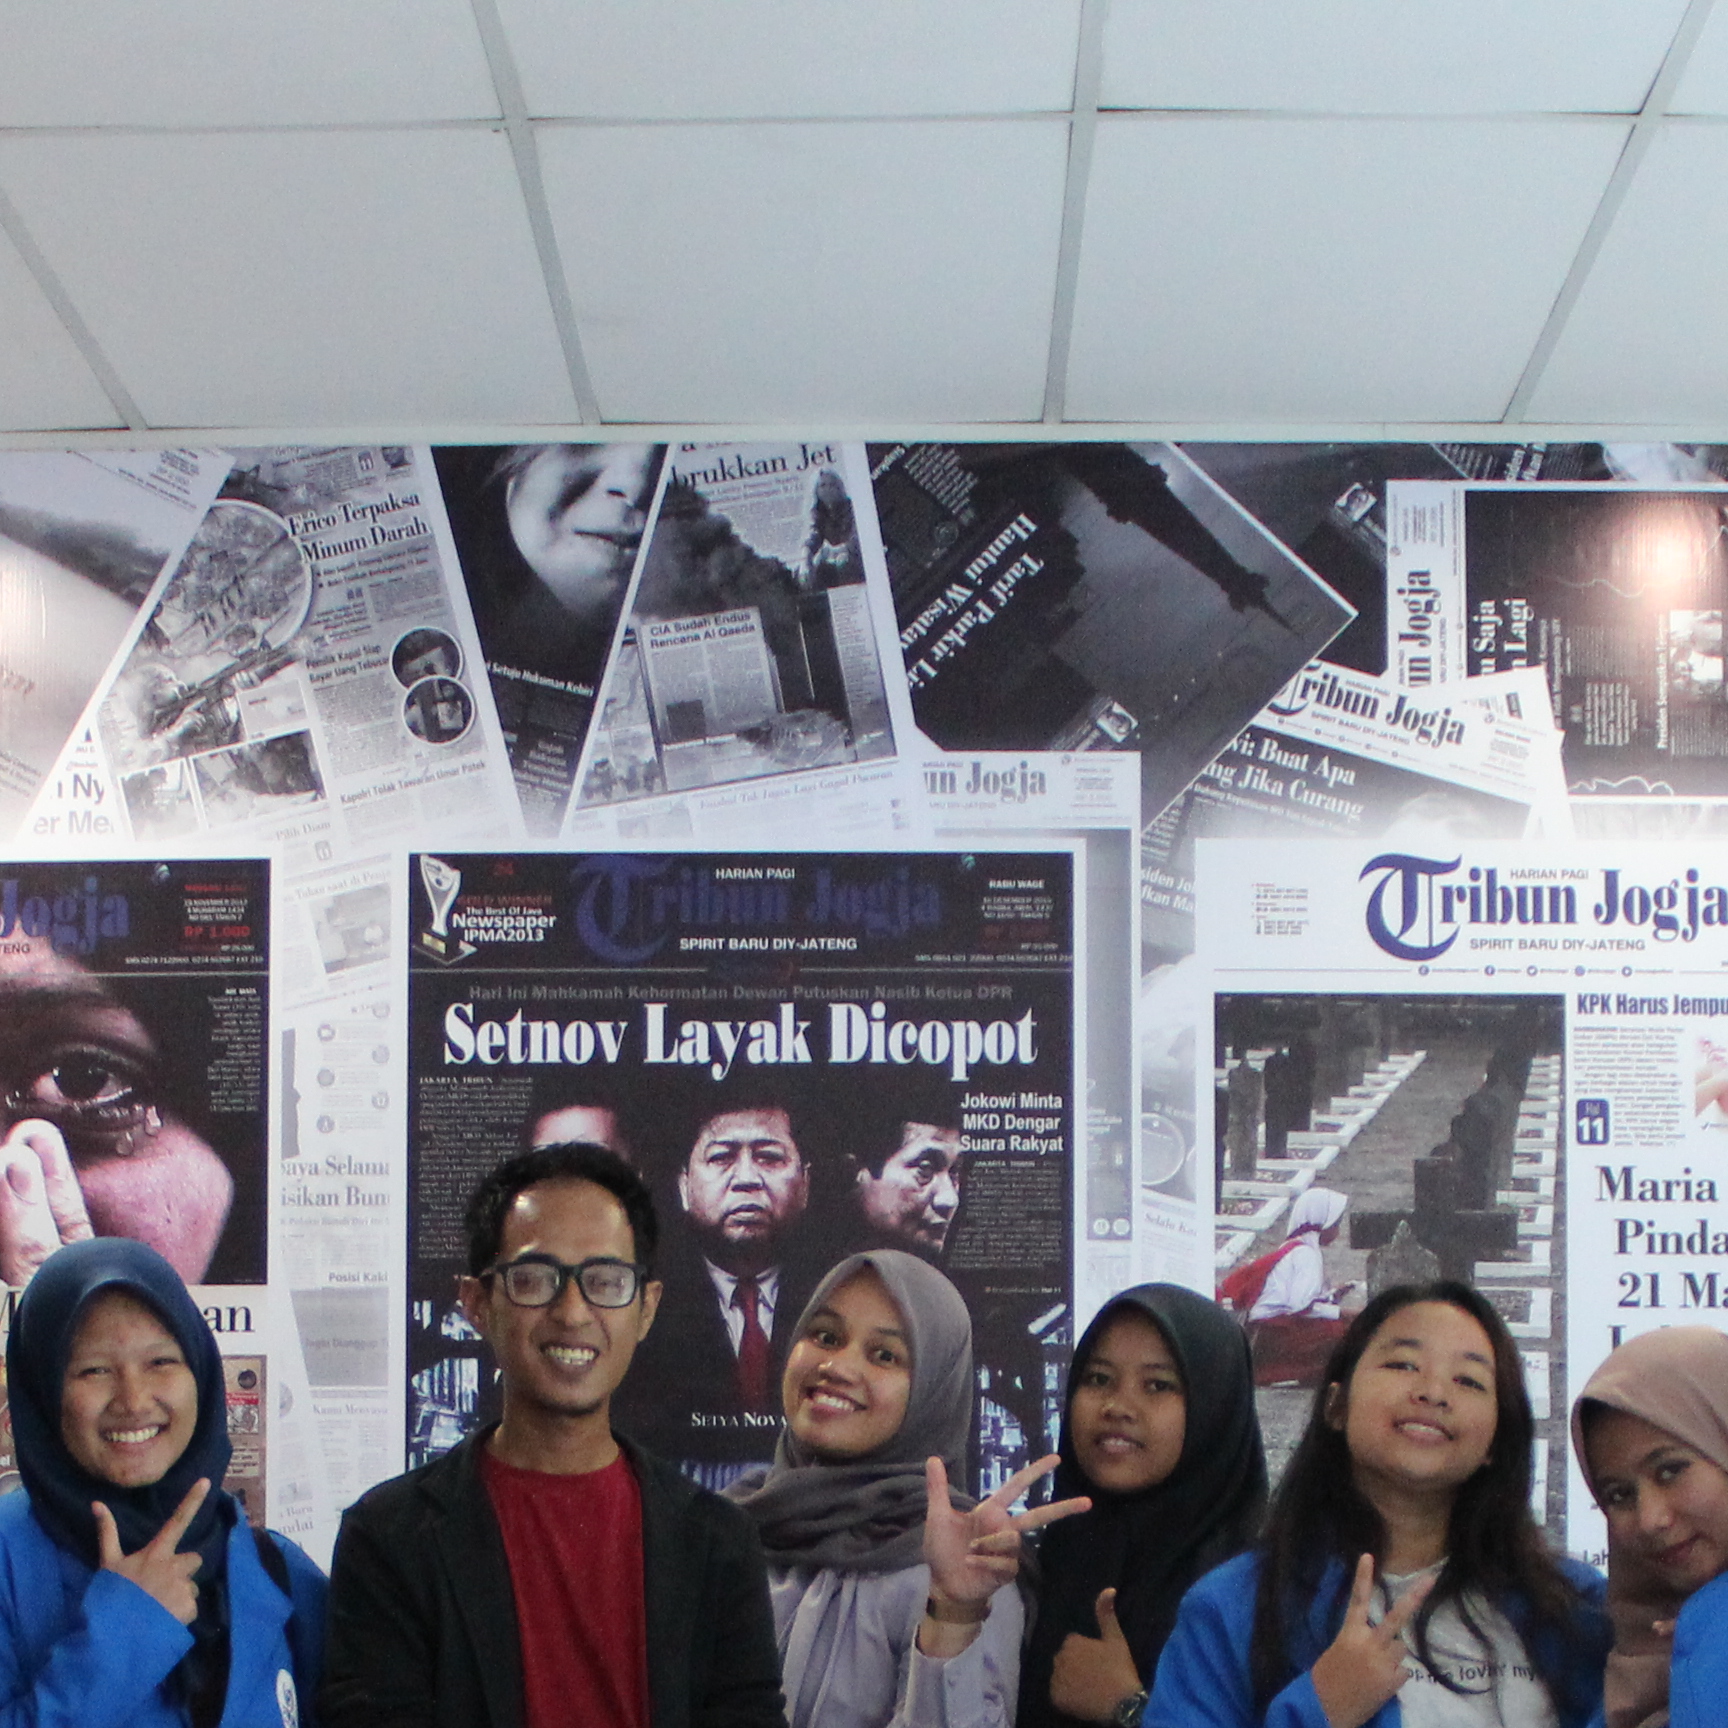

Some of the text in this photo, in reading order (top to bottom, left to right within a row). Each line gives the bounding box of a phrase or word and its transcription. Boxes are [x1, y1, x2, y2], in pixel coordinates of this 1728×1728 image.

[796, 444, 838, 474] Jet
[286, 492, 421, 539] Erico Terpaksa
[299, 519, 432, 565] Minum Darah
[965, 513, 1039, 586] Hantui
[908, 552, 1045, 688] Tarif Parkir Li
[1397, 568, 1442, 648] Jogja
[649, 624, 757, 650] Rencana Al Qaeda
[650, 611, 752, 637] CIA Sudah Endus
[1473, 599, 1505, 653] Saja
[1504, 597, 1535, 653] Lagi
[492, 661, 521, 683] Setuju
[522, 668, 565, 691] Hukuman
[1384, 693, 1468, 749] Jogja
[1259, 737, 1358, 787] Buat Apa
[965, 760, 1048, 805] Jogja
[1237, 764, 1284, 799] Jika
[1288, 780, 1365, 823] Curang
[715, 867, 796, 880] HARIAN PAGI
[1509, 867, 1591, 882] HARIAN PAGI
[452, 912, 557, 931] Newspaper
[465, 907, 543, 917] The Best Of Java
[571, 855, 788, 964] Tribun
[808, 866, 941, 938] Jogja
[1357, 852, 1580, 963] Tribun
[463, 929, 545, 943] IPMA2013
[679, 937, 859, 951] SPIRIT BARU DIY-JATENG
[1468, 937, 1647, 952] SPIRIT BARU DIY-JATENG
[469, 985, 1014, 1000] Hari Ini Mahkamah Kehormatan Dewan Putuskan Nasib Ketua DPR
[1576, 993, 1612, 1016] KPK
[1616, 993, 1669, 1016] Harus
[444, 1001, 1040, 1083] Setnov Layak Dicopot
[959, 1092, 1064, 1111] Jokowi Minta
[962, 1113, 1062, 1135] MKD Dengar
[1577, 1117, 1605, 1142] 11
[959, 1135, 1065, 1156] Suara Rakyat
[1595, 1165, 1719, 1204] Maria
[328, 1271, 389, 1283] Posisi Kaki
[1617, 1272, 1668, 1310] 21
[691, 1411, 740, 1428] SETYA
[1512, 1663, 1536, 1682] my
